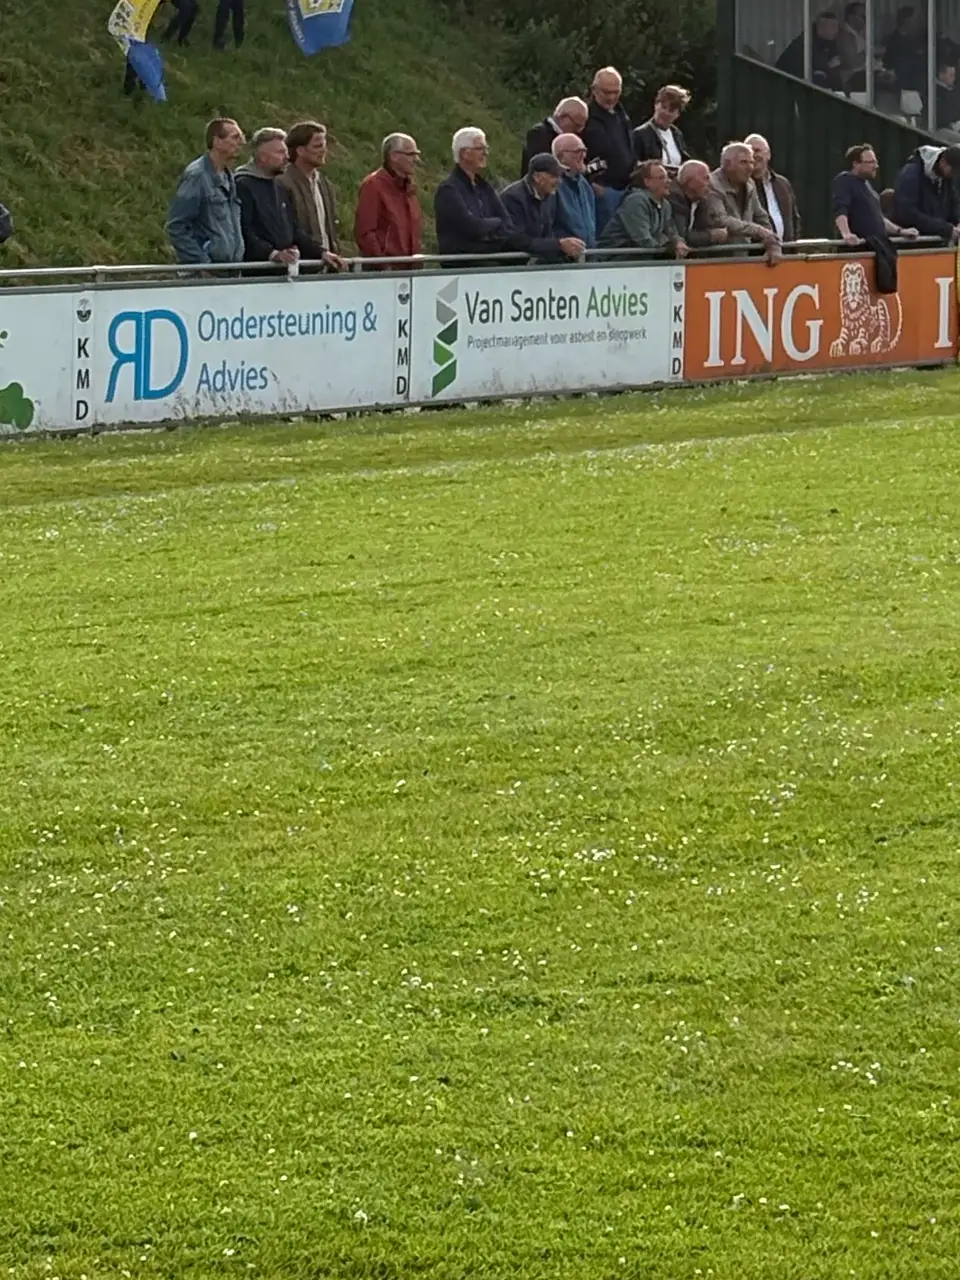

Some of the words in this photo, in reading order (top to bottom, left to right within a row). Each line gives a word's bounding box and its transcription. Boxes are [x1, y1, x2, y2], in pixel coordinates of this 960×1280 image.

[198, 305, 357, 343] Ondersteuning
[362, 300, 378, 332] &
[465, 291, 503, 325] Van
[510, 287, 580, 322] Santen
[586, 284, 649, 319] Advies
[703, 284, 824, 368] ING
[75, 336, 91, 421] KMD
[196, 359, 268, 396] Advies
